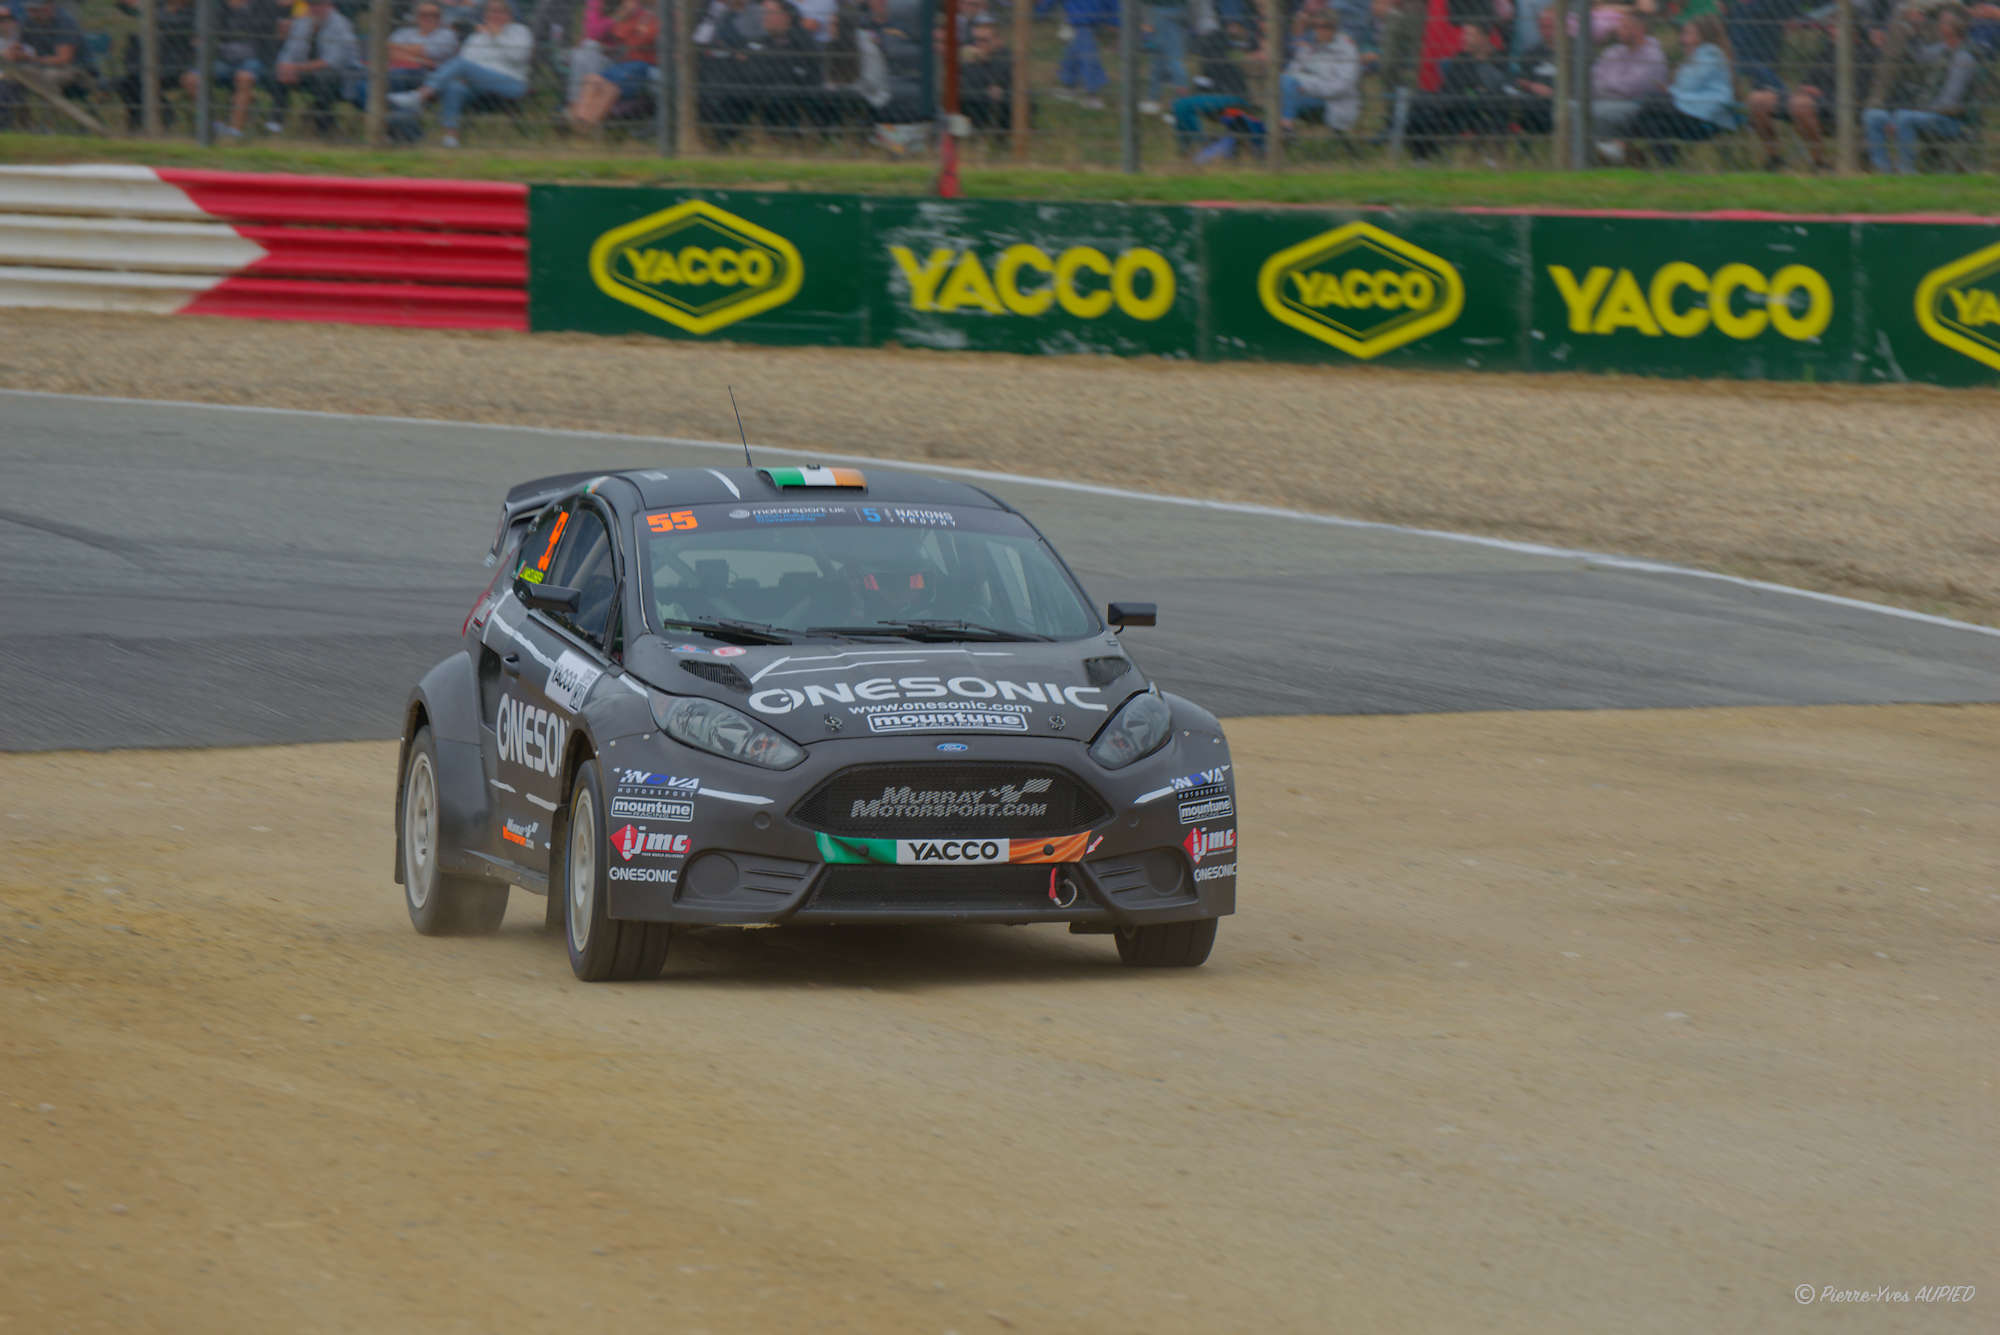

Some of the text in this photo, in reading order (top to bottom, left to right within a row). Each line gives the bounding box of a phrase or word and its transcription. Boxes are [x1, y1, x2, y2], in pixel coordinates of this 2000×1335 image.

[624, 246, 774, 287] YACCO
[891, 244, 1176, 320] YACCO
[1291, 269, 1437, 310] YACCO
[1547, 261, 1833, 340] YACCO
[646, 510, 698, 532] 55
[862, 507, 881, 522] 5
[895, 508, 953, 520] NATIONS
[749, 676, 1109, 713] ONESONIC
[848, 700, 1032, 714] www.onesonic.com
[873, 712, 1021, 726] mountune
[614, 801, 691, 815] mountune
[630, 825, 689, 854] jmc
[908, 841, 999, 861] YACCO
[1199, 826, 1235, 857] jmc
[609, 866, 678, 883] ONESONIC
